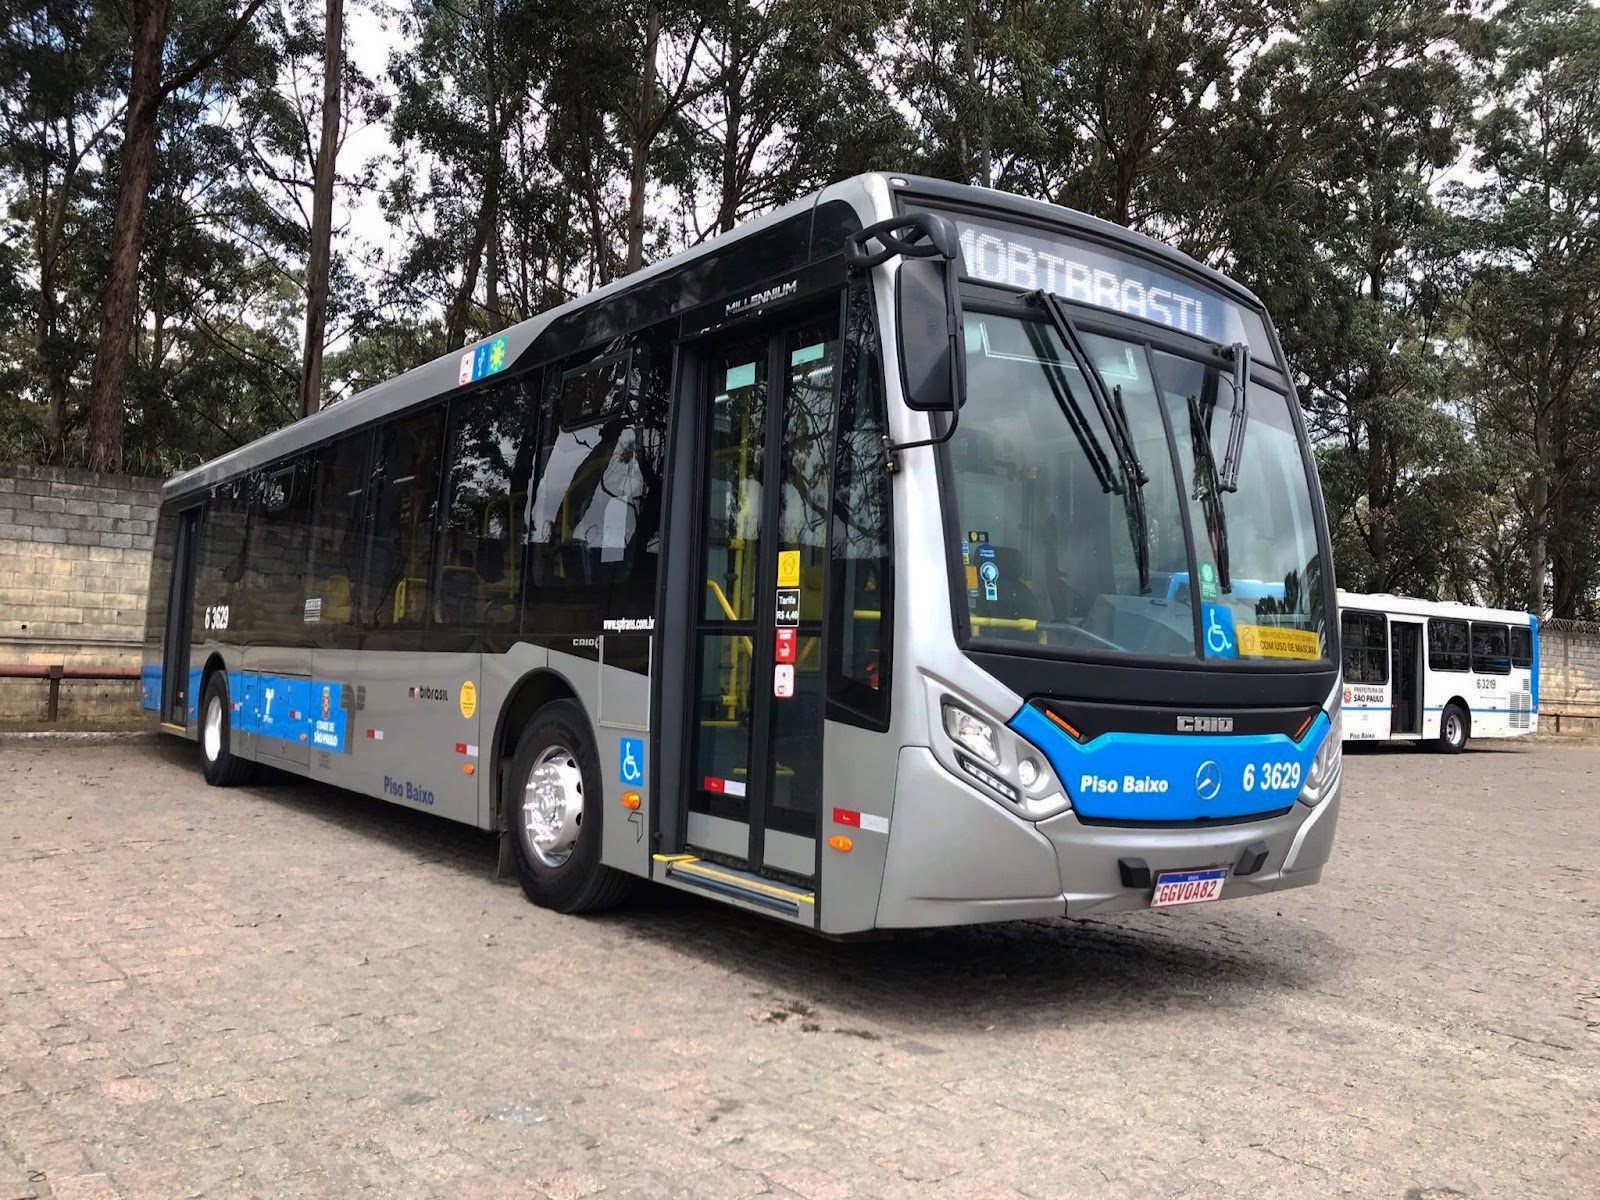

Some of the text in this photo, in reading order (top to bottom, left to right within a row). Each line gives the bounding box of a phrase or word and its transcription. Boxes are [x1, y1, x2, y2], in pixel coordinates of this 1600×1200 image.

[725, 279, 798, 316] MILLENNIUM
[778, 596, 796, 605] Tarifa
[204, 605, 229, 630] 6 3629
[572, 638, 595, 647] CAIO
[409, 686, 448, 701] mobibrasil
[1354, 692, 1384, 703] SÃO PAULO
[1176, 716, 1233, 732] CAIO
[1080, 775, 1169, 793] Piso Baixo
[1242, 762, 1301, 792] 6 3629
[383, 775, 434, 806] Piso Baixo
